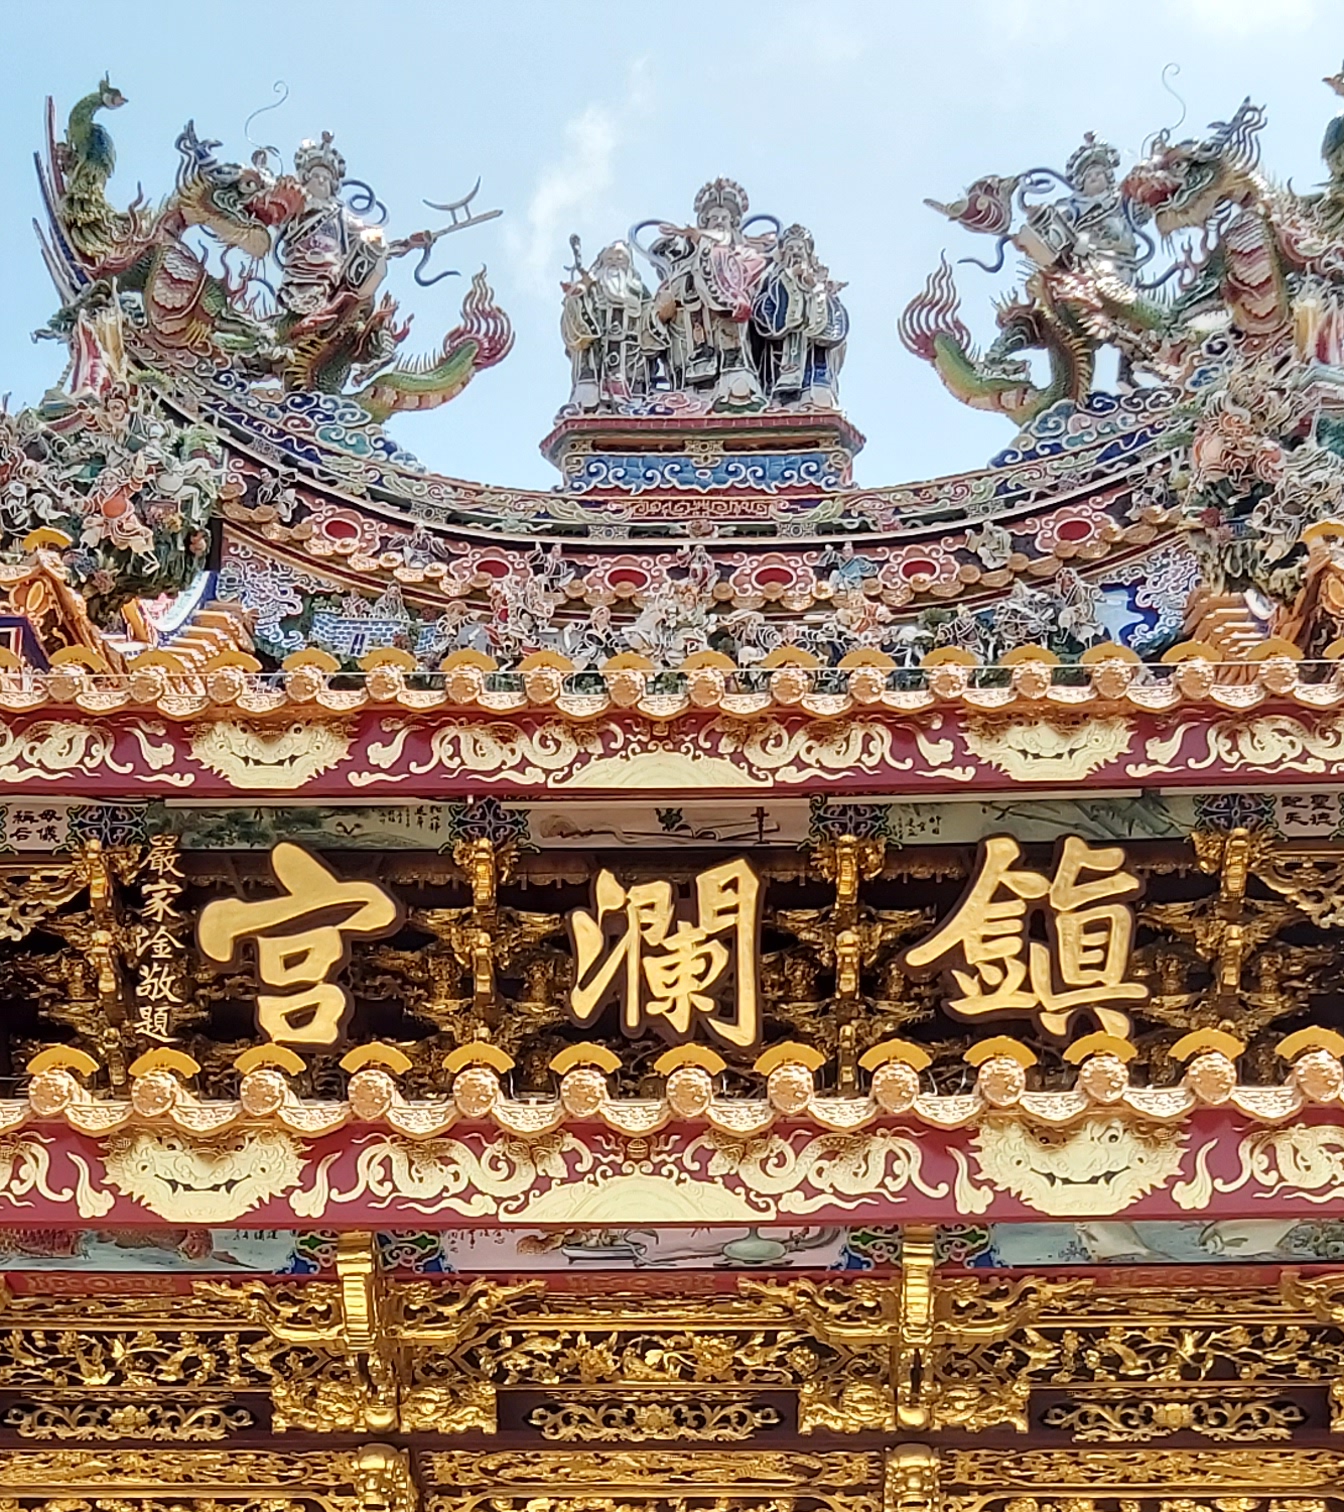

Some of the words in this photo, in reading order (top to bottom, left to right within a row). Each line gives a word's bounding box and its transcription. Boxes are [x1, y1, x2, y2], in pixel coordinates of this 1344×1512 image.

[134, 835, 185, 1043] 嚴家淦敬題
[197, 837, 1152, 1046] 鎮瀾宮
